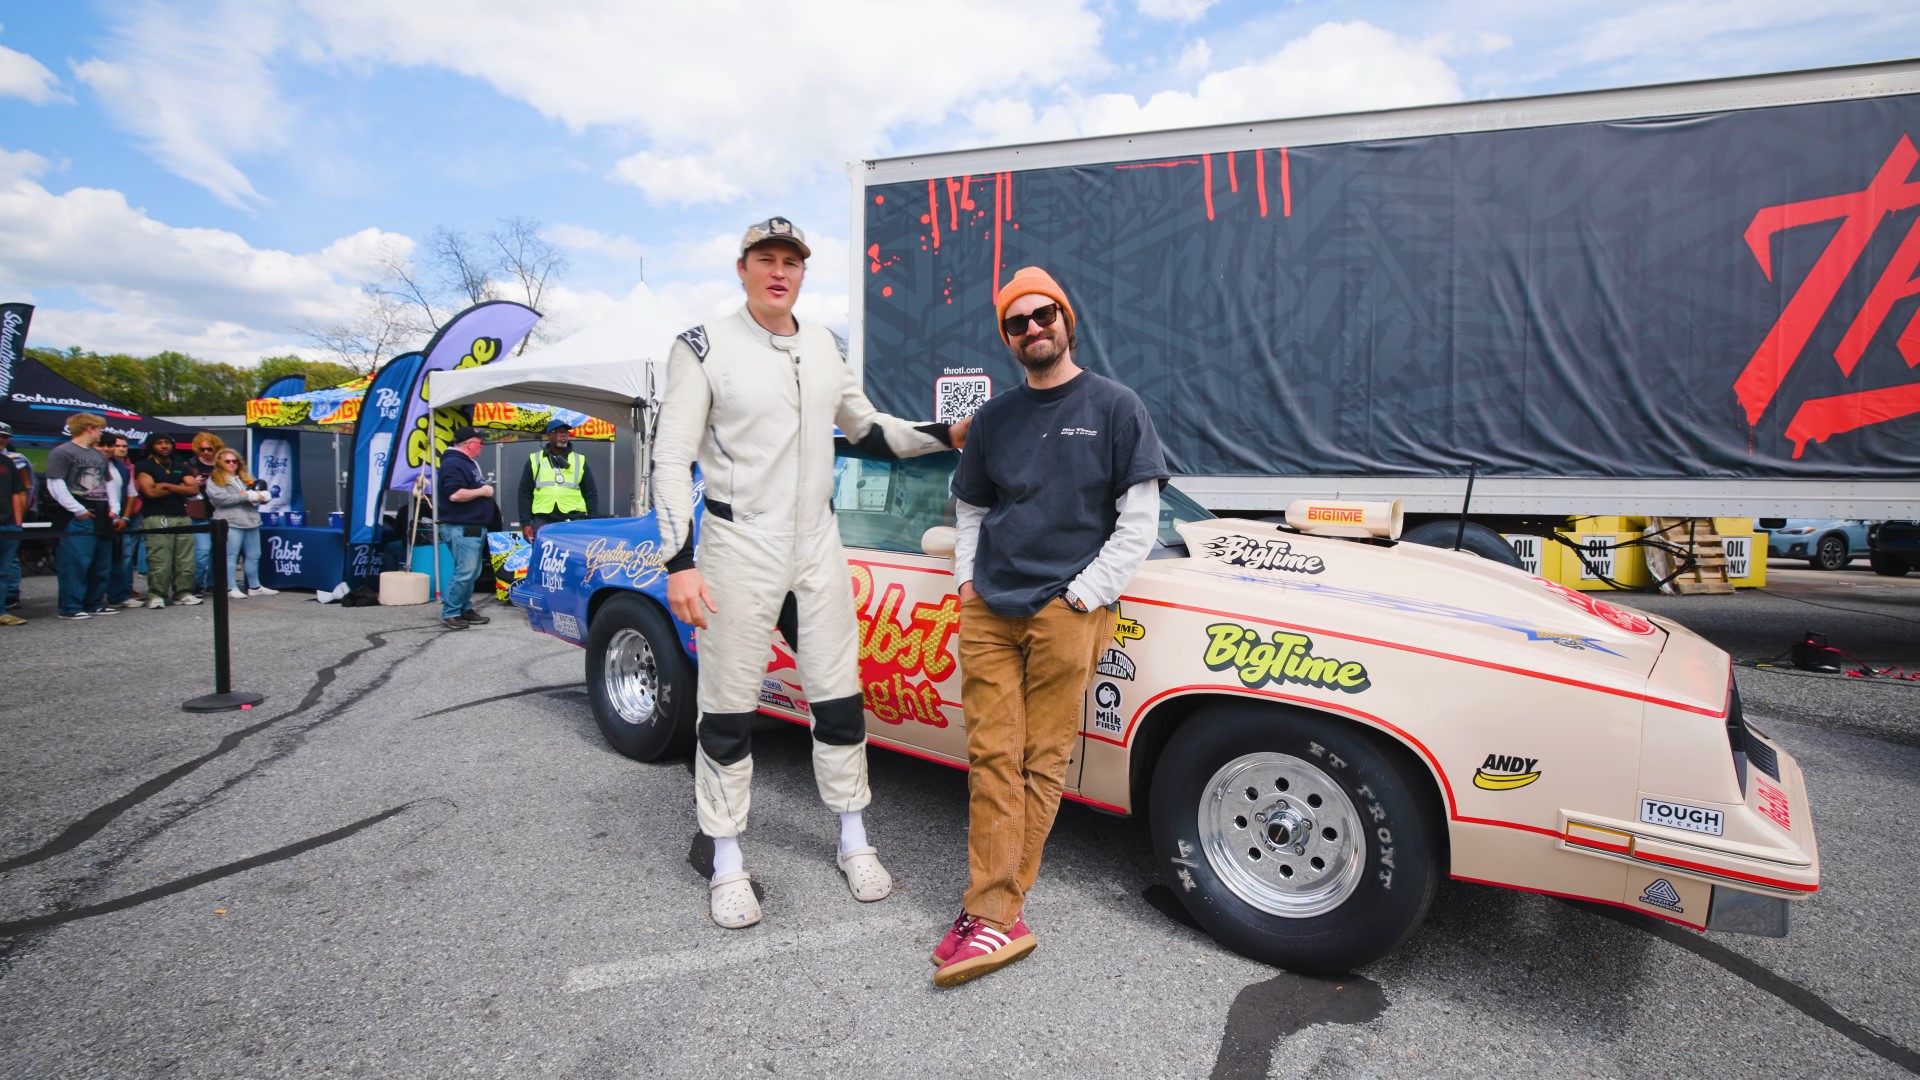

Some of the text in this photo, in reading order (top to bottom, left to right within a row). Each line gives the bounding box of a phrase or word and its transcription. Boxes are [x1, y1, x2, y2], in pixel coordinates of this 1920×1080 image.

[943, 366, 983, 375] throtl.com
[1307, 507, 1363, 523] BIGTIME
[268, 535, 303, 560] Pabst
[1222, 535, 1325, 574] BigTime
[1514, 540, 1535, 558] OIL
[1589, 539, 1609, 558] OIL
[1727, 540, 1745, 558] OIL
[539, 541, 570, 573] Pabst
[275, 560, 301, 576] Light
[1726, 560, 1747, 574] NLY
[542, 572, 564, 593] Light
[1115, 623, 1139, 635] IME
[1099, 650, 1135, 679] RA TOUGH
[1203, 623, 1371, 694] BigTime
[1096, 708, 1121, 726] Milk
[1096, 720, 1121, 733] FIRST
[1482, 754, 1538, 775] ANDY
[1309, 740, 1395, 889] ET FRONT
[1647, 802, 1719, 827] TOUGH
[1648, 816, 1718, 833] KNUCKLES
[1640, 897, 1683, 912] DENNISON
